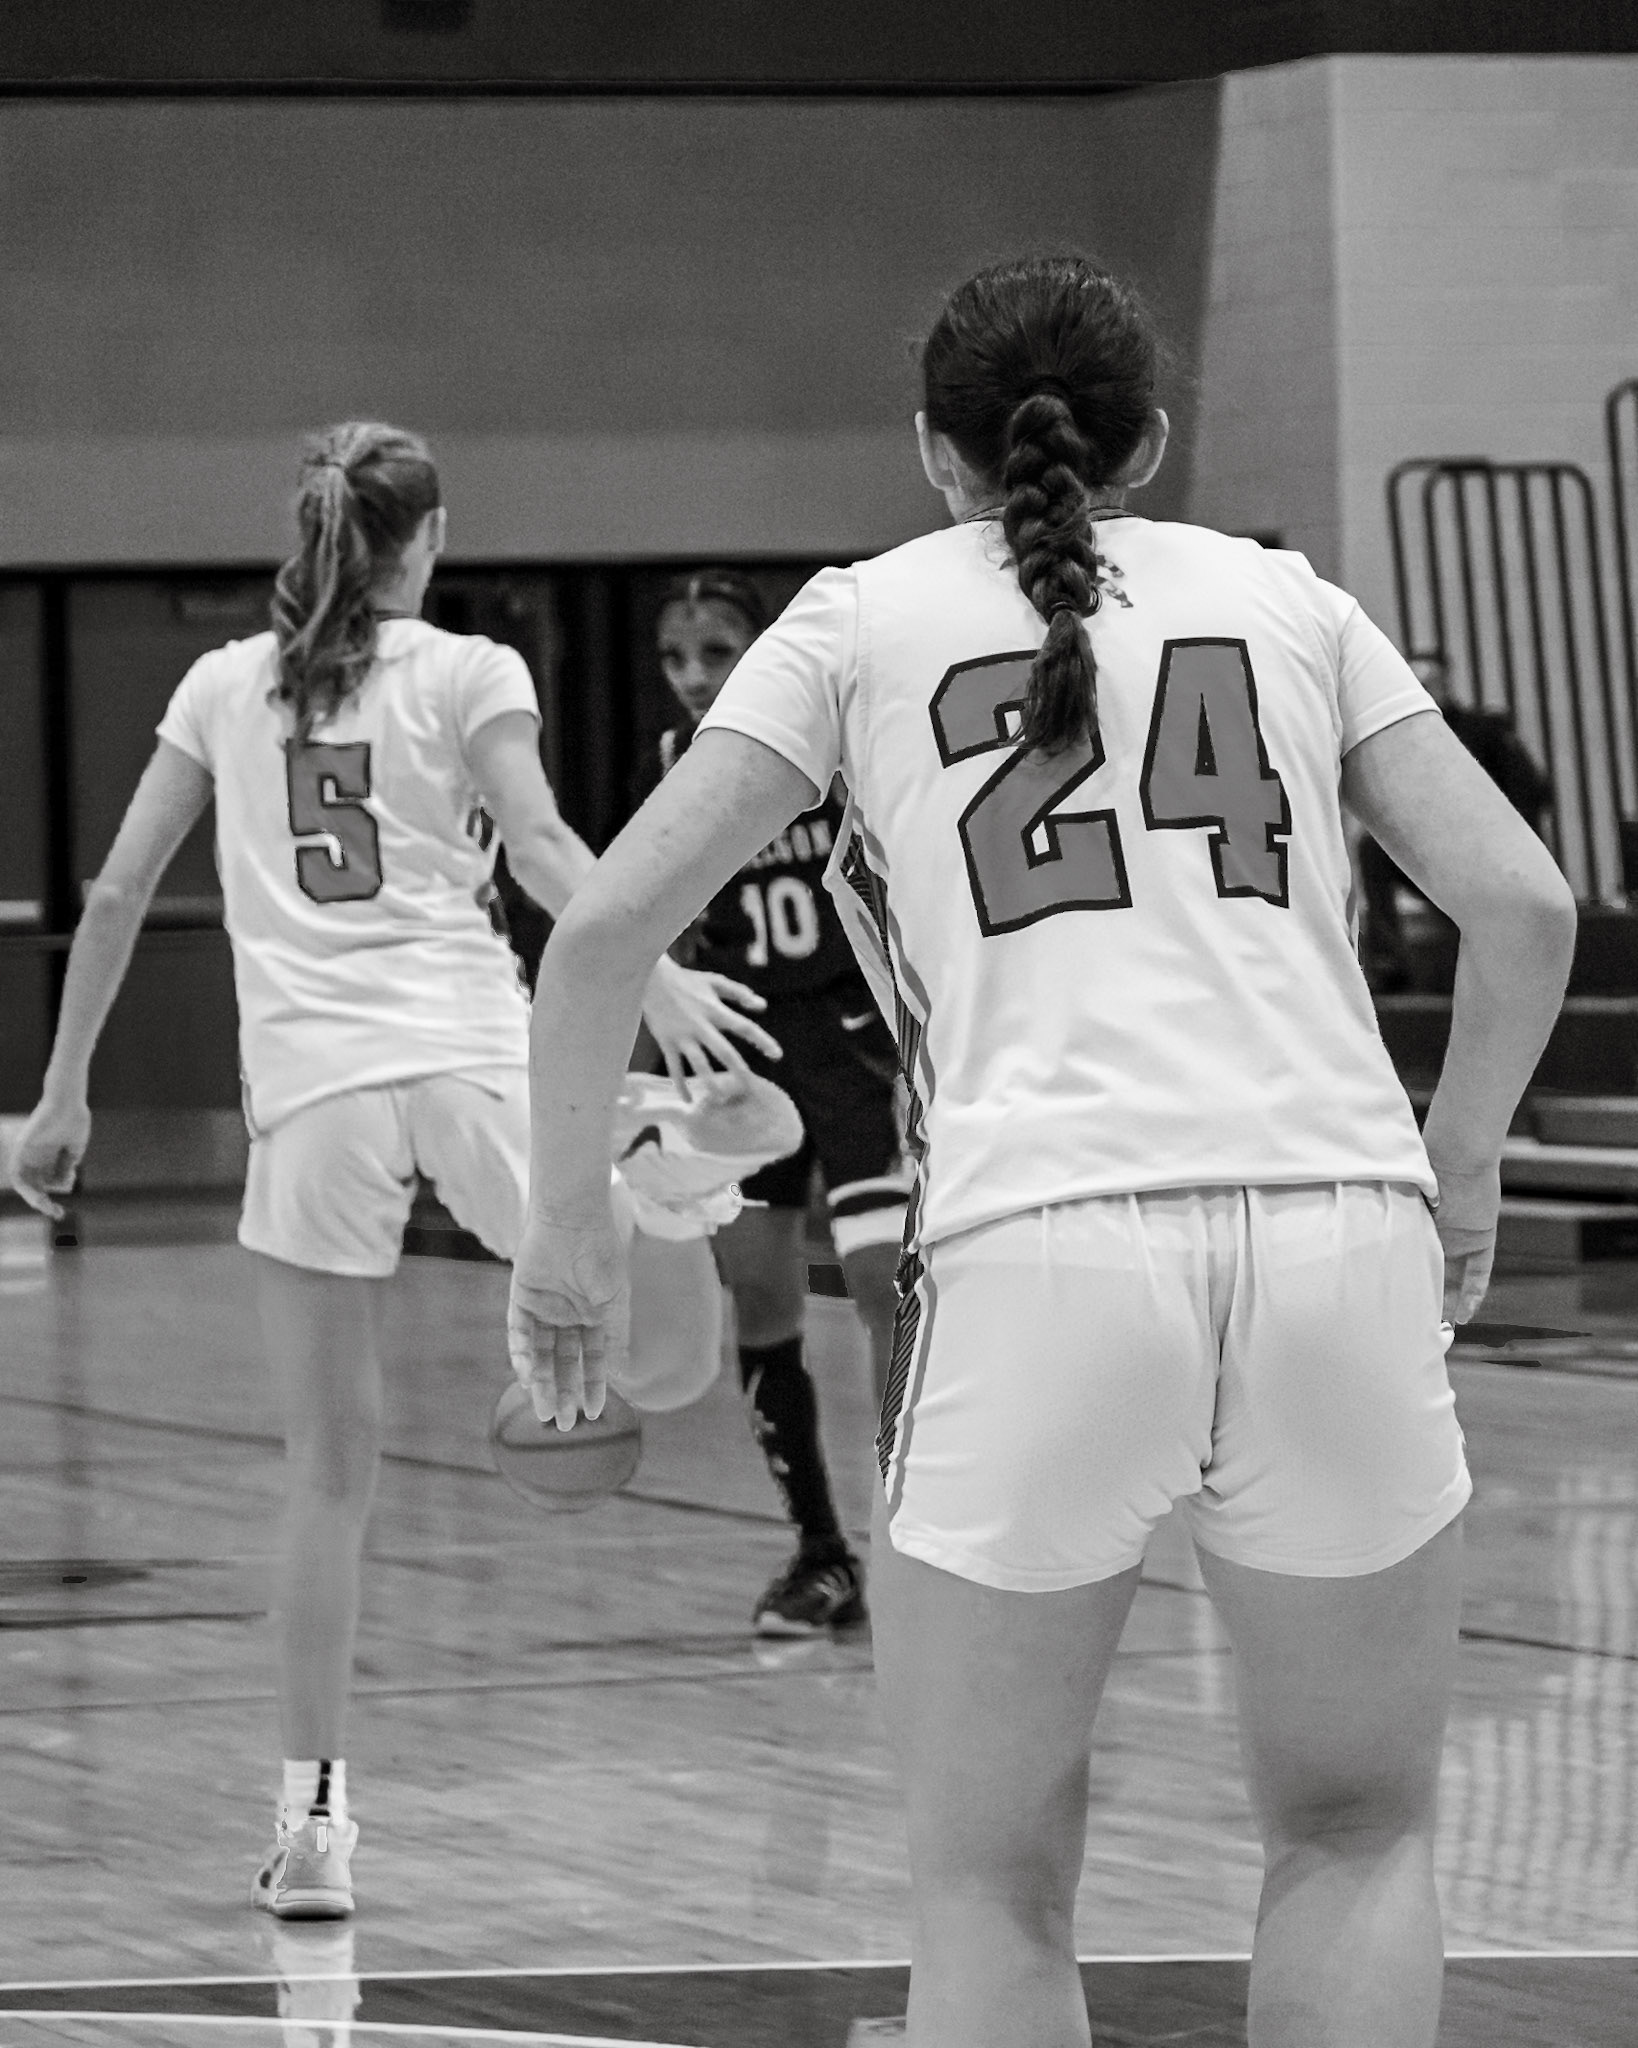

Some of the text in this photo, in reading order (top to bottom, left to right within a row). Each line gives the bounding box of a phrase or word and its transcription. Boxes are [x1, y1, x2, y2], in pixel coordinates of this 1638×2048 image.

[286, 739, 383, 904] 5
[928, 637, 1292, 938] 24
[740, 876, 819, 966] 10
